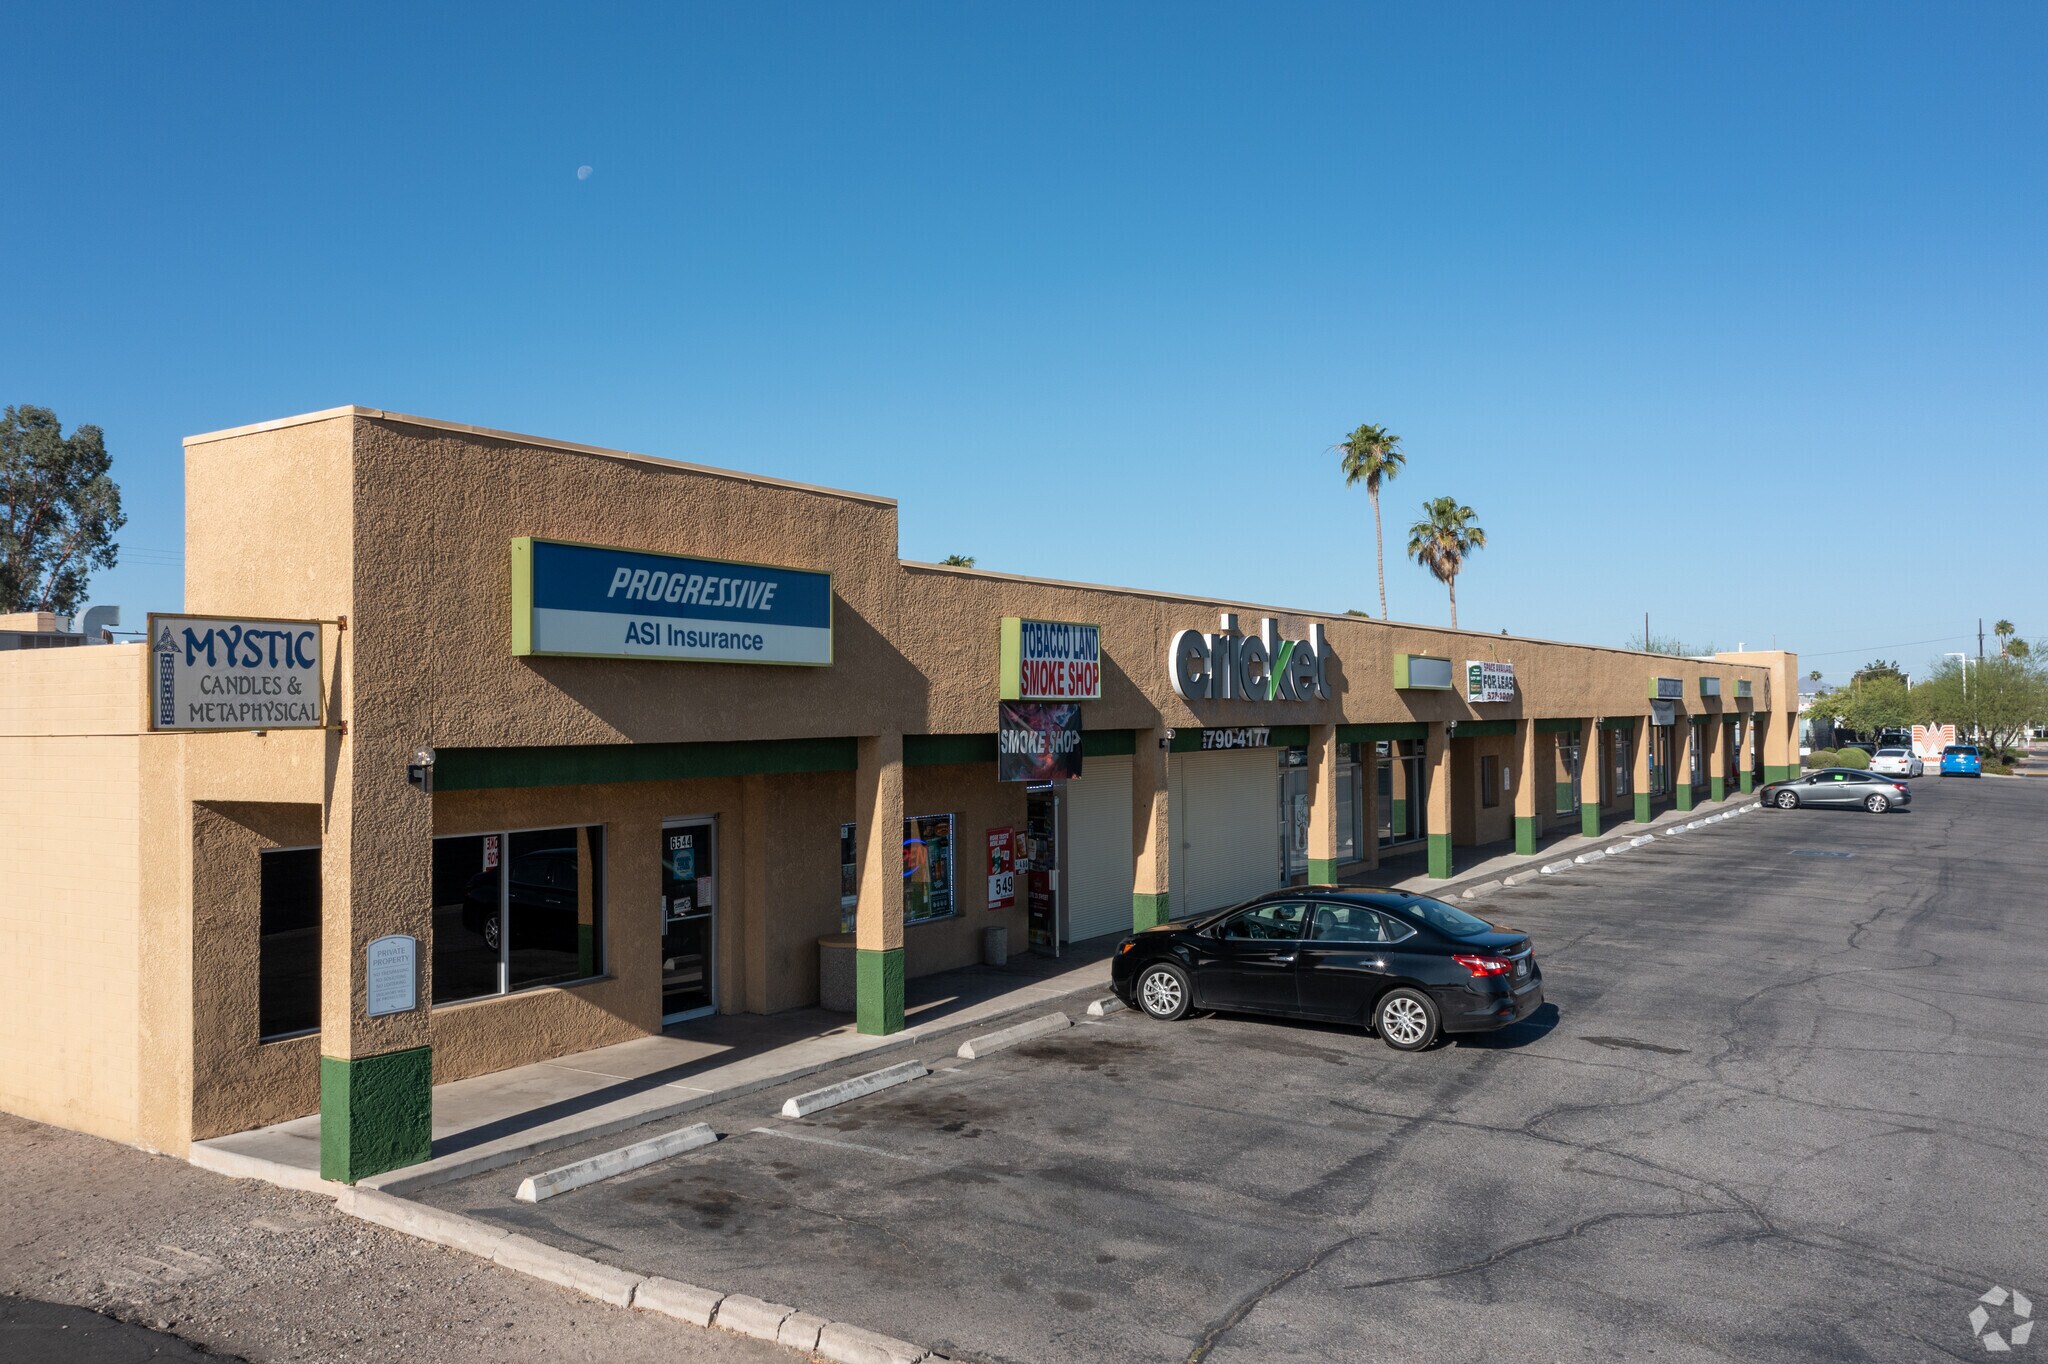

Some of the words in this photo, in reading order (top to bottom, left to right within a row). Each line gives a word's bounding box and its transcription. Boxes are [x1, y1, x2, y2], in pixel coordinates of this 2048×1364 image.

[607, 567, 777, 611] PROGRESSIVE
[181, 624, 316, 669] MYSTIC
[624, 621, 661, 646] ASI
[667, 624, 764, 651] Insurance
[1021, 622, 1070, 660] TOBACCO
[1073, 626, 1099, 661] LAND
[1168, 613, 1333, 701] cricket
[200, 675, 281, 695] CANDLES
[287, 676, 302, 695] &
[1021, 660, 1065, 696] SMOKE
[1068, 661, 1099, 696] SHOP
[1483, 674, 1497, 689] FOR
[1497, 675, 1514, 690] LEAS
[188, 701, 320, 723] METAPHYSICAL
[1000, 729, 1046, 754] SMOKE
[1048, 730, 1080, 753] SHOP
[1206, 729, 1270, 749] 790-4177
[671, 836, 692, 850] 6544
[995, 876, 1013, 895] 549
[373, 955, 409, 966] PROPERTY
[377, 947, 406, 957] PRIVATE
